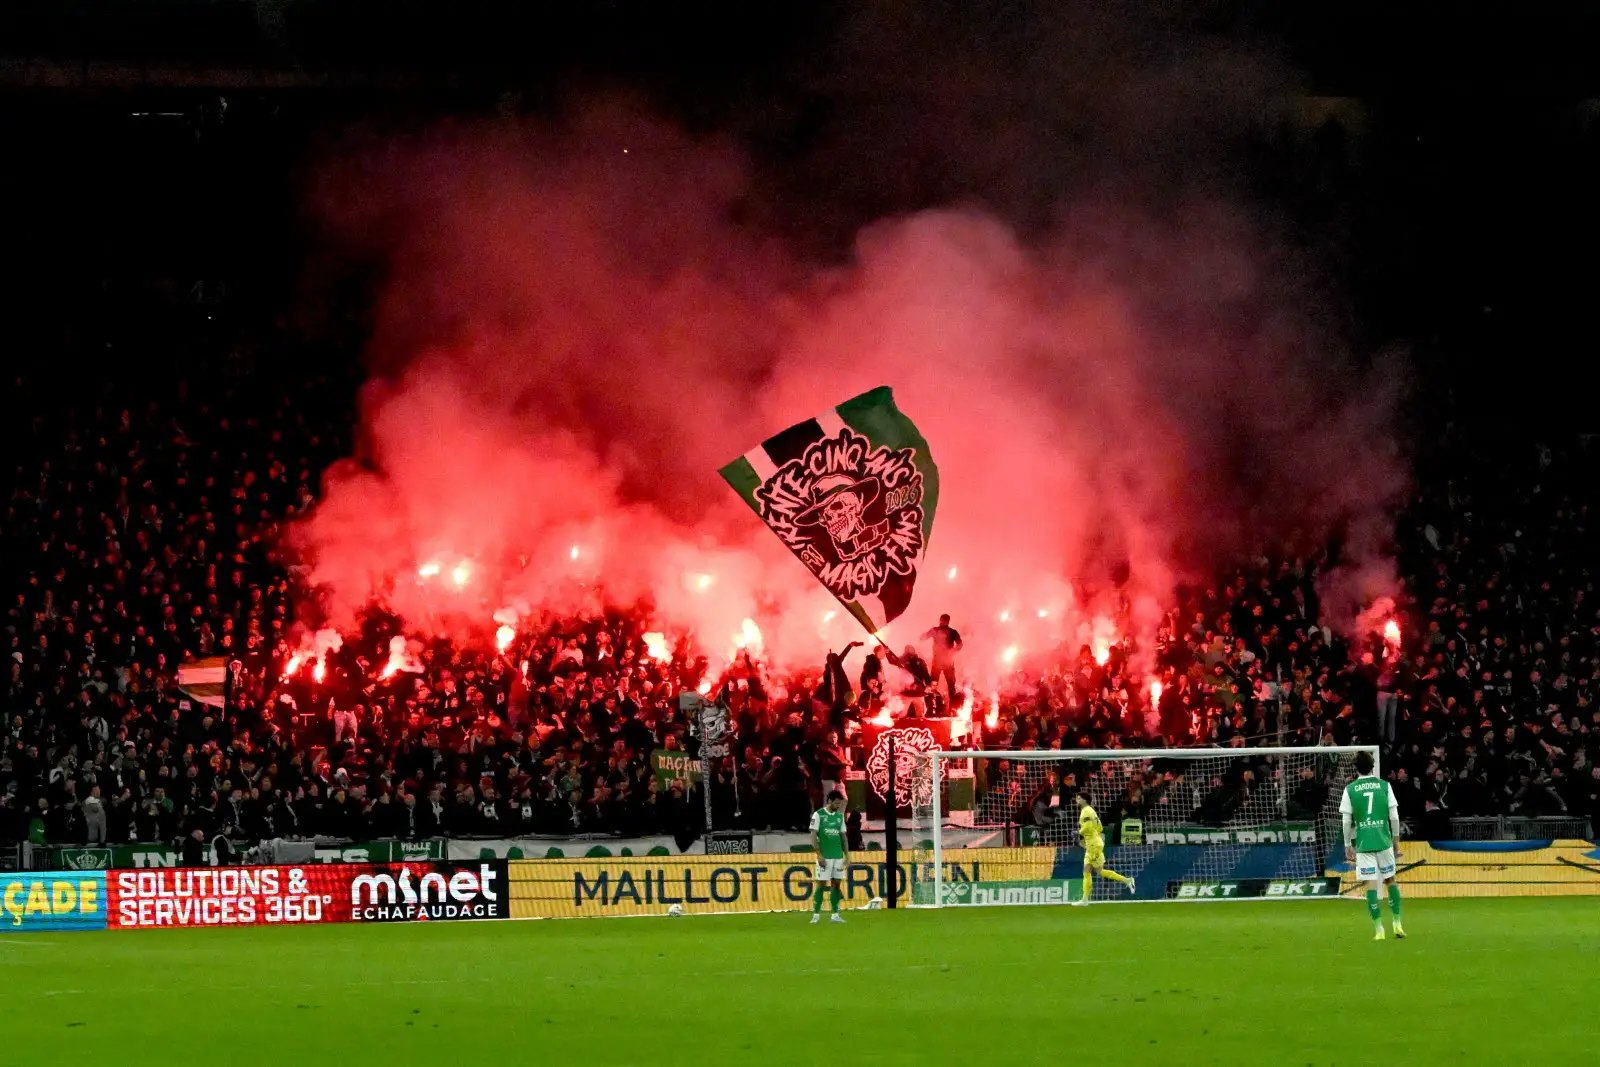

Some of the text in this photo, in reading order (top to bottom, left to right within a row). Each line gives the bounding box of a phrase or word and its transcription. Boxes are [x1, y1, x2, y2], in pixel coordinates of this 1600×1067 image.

[885, 482, 919, 515] 2026
[819, 552, 883, 595] MAGIC
[880, 510, 918, 567] FANS
[1354, 782, 1381, 792] CARDONA
[1363, 792, 1374, 814] 7
[711, 839, 749, 854] AVEC
[119, 868, 309, 898] SOLUTIONS &
[574, 863, 979, 907] MAILLOT GRDIN
[971, 881, 1069, 904] hummel
[1178, 885, 1237, 897] BKT
[1266, 882, 1327, 895] BKT
[0, 881, 98, 925] ÇADE
[119, 895, 332, 926] SERVICES 360°
[352, 903, 498, 920] ECHAFAUDAGE
